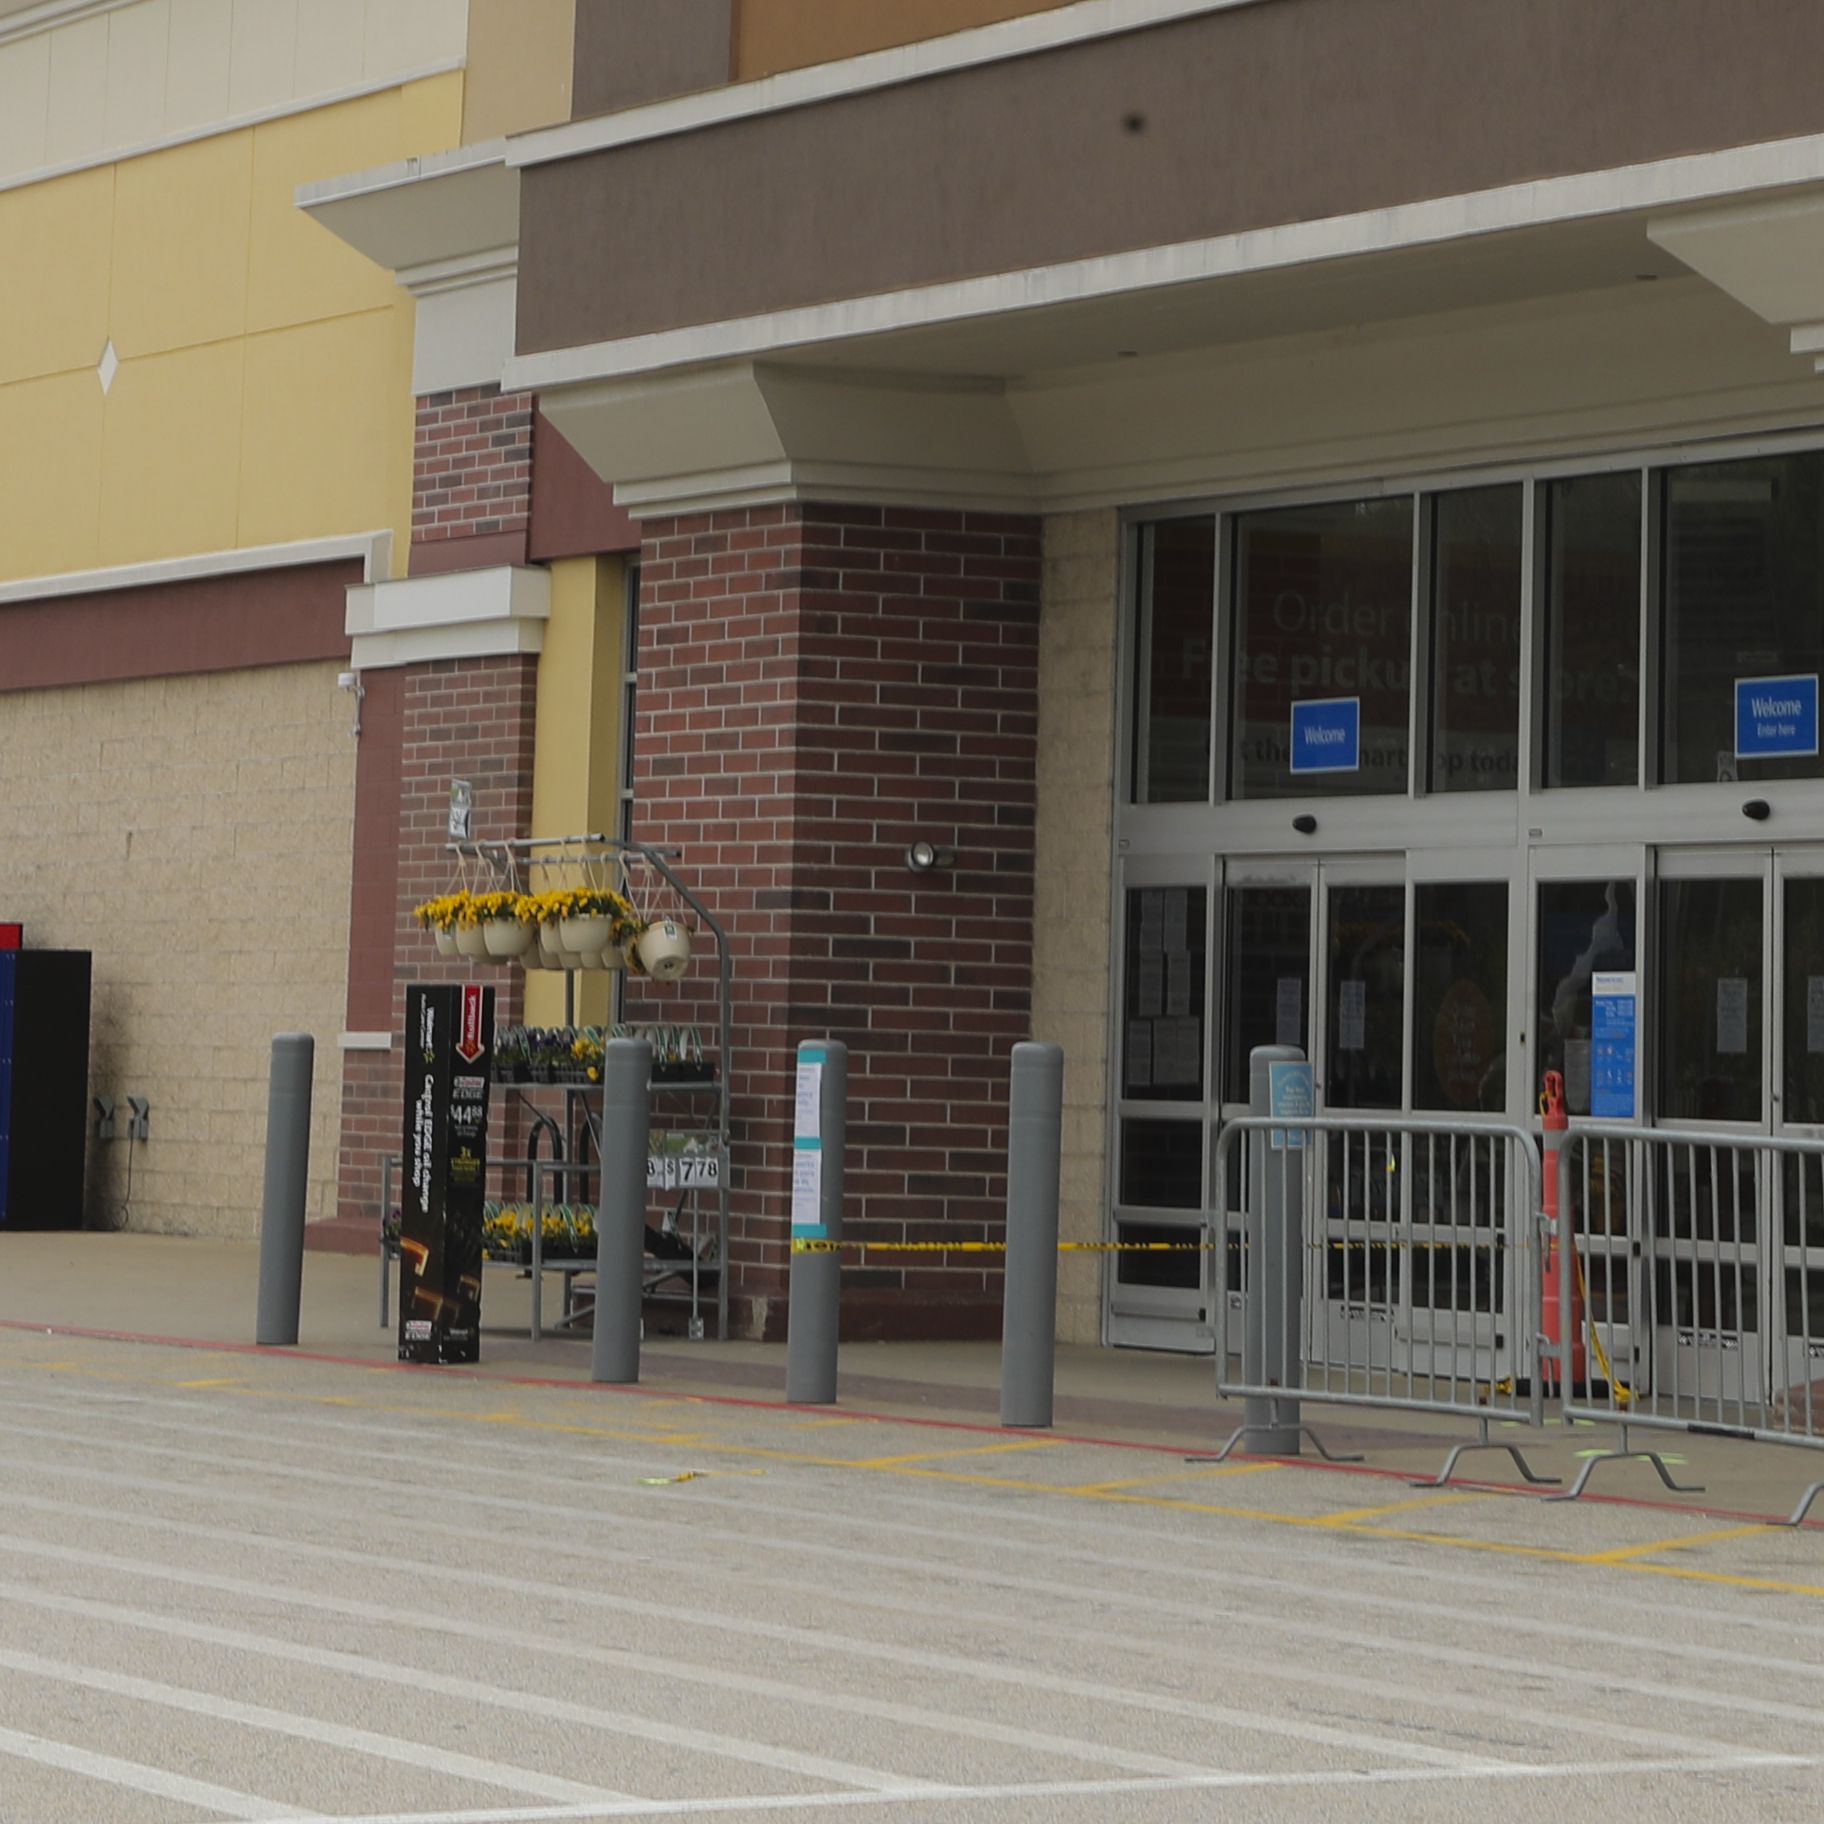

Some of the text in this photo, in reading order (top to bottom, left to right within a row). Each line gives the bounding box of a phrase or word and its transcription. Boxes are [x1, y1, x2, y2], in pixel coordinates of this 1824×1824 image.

[1751, 695, 1802, 718] Welcome
[1304, 725, 1346, 745] Welcome
[1757, 721, 1796, 738] Enter here
